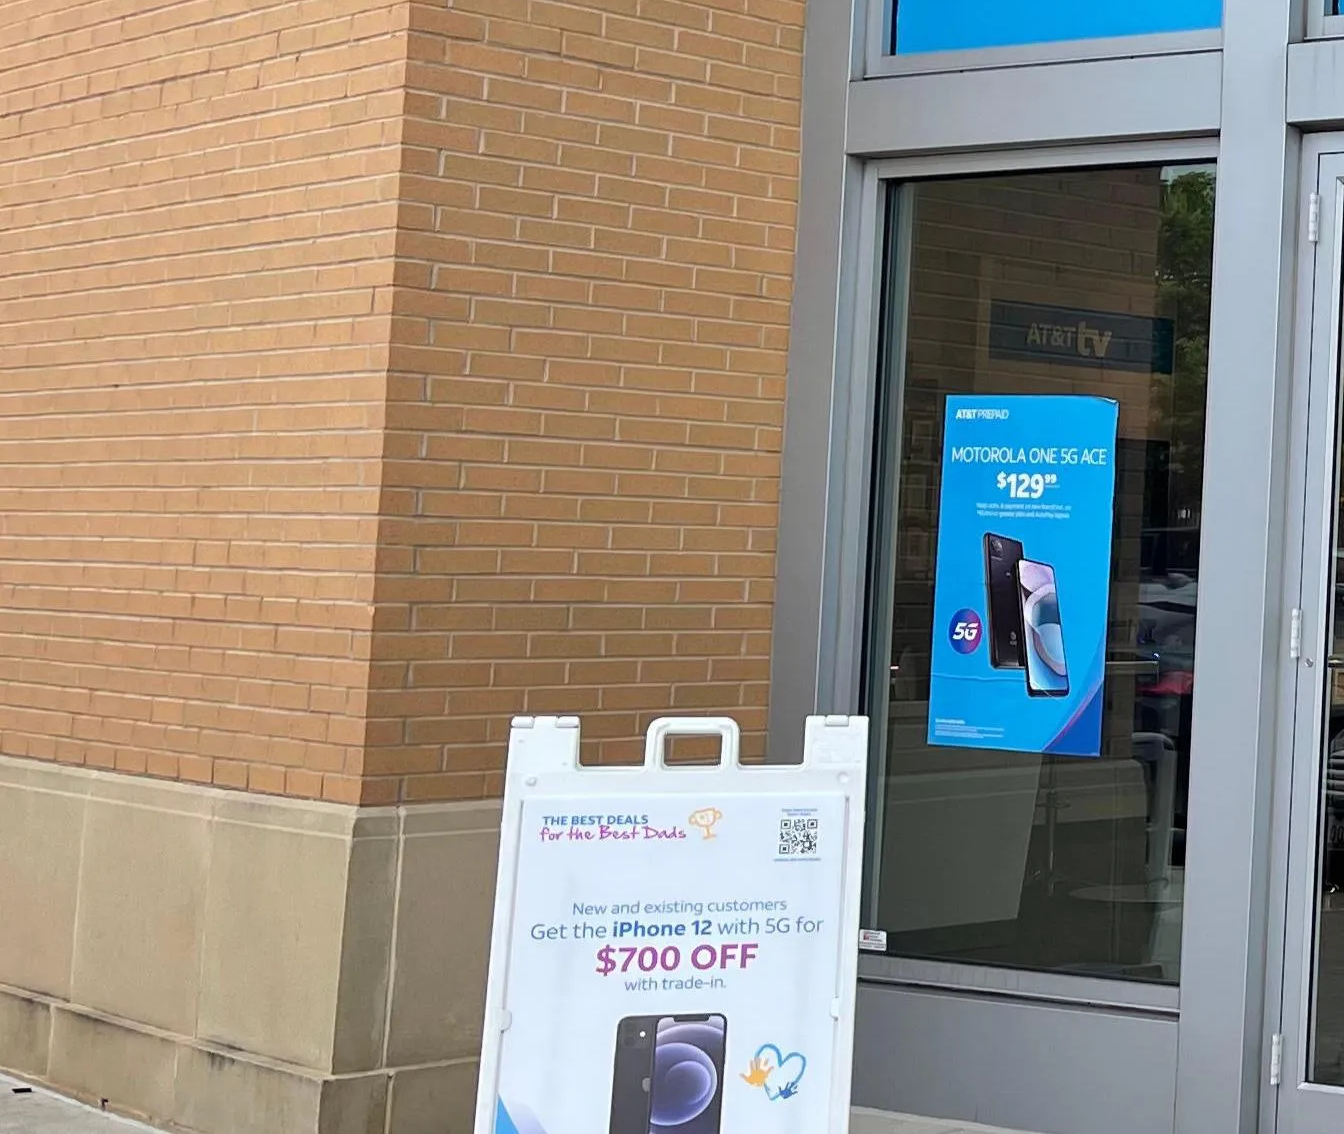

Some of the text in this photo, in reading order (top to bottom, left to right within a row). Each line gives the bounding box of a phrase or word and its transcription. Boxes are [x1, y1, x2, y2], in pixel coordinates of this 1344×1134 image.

[977, 409, 1009, 420] PREPAID
[951, 446, 1108, 465] MOTOROLA ONE 5G ACE
[952, 622, 979, 641] 5G
[542, 814, 649, 826] THE BEST DEALS
[540, 824, 687, 842] for the Best Dads
[572, 899, 787, 916] New and existing customers
[531, 916, 824, 940] Get the iPhone 12 with 5G for
[595, 943, 759, 977] $700 OFF
[624, 975, 727, 991] with trade-in.
